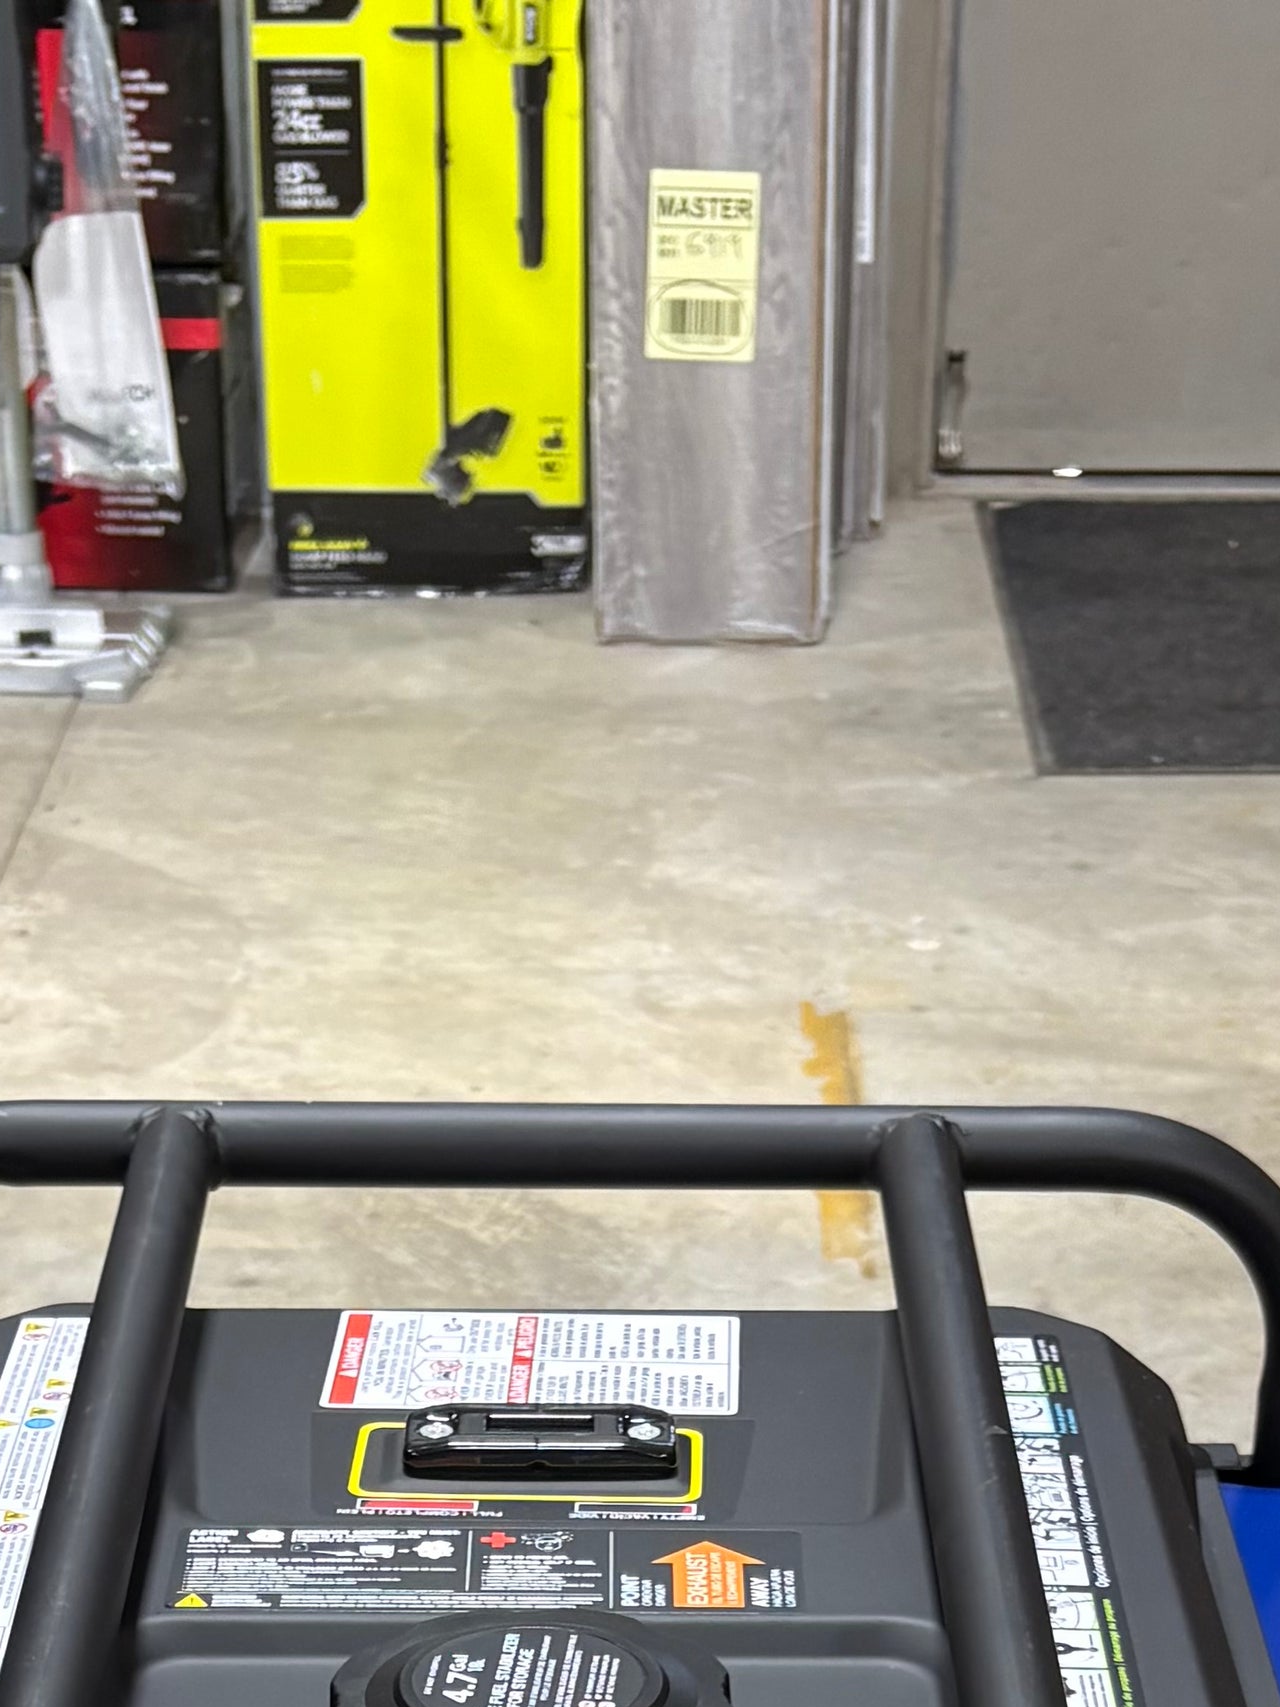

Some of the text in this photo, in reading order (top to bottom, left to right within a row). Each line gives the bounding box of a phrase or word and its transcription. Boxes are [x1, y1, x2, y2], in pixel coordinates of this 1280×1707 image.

[657, 195, 753, 220] MASTER
[341, 1337, 364, 1369] DANGER
[622, 1575, 640, 1607] POINT
[687, 1552, 709, 1605] EXHAUST
[751, 1576, 769, 1607] AWAY
[495, 1633, 520, 1682] STABILIZER
[512, 1648, 535, 1690] STORAGE
[442, 1654, 477, 1703] 4.7 Gal
[490, 1683, 508, 1704] FUEL
